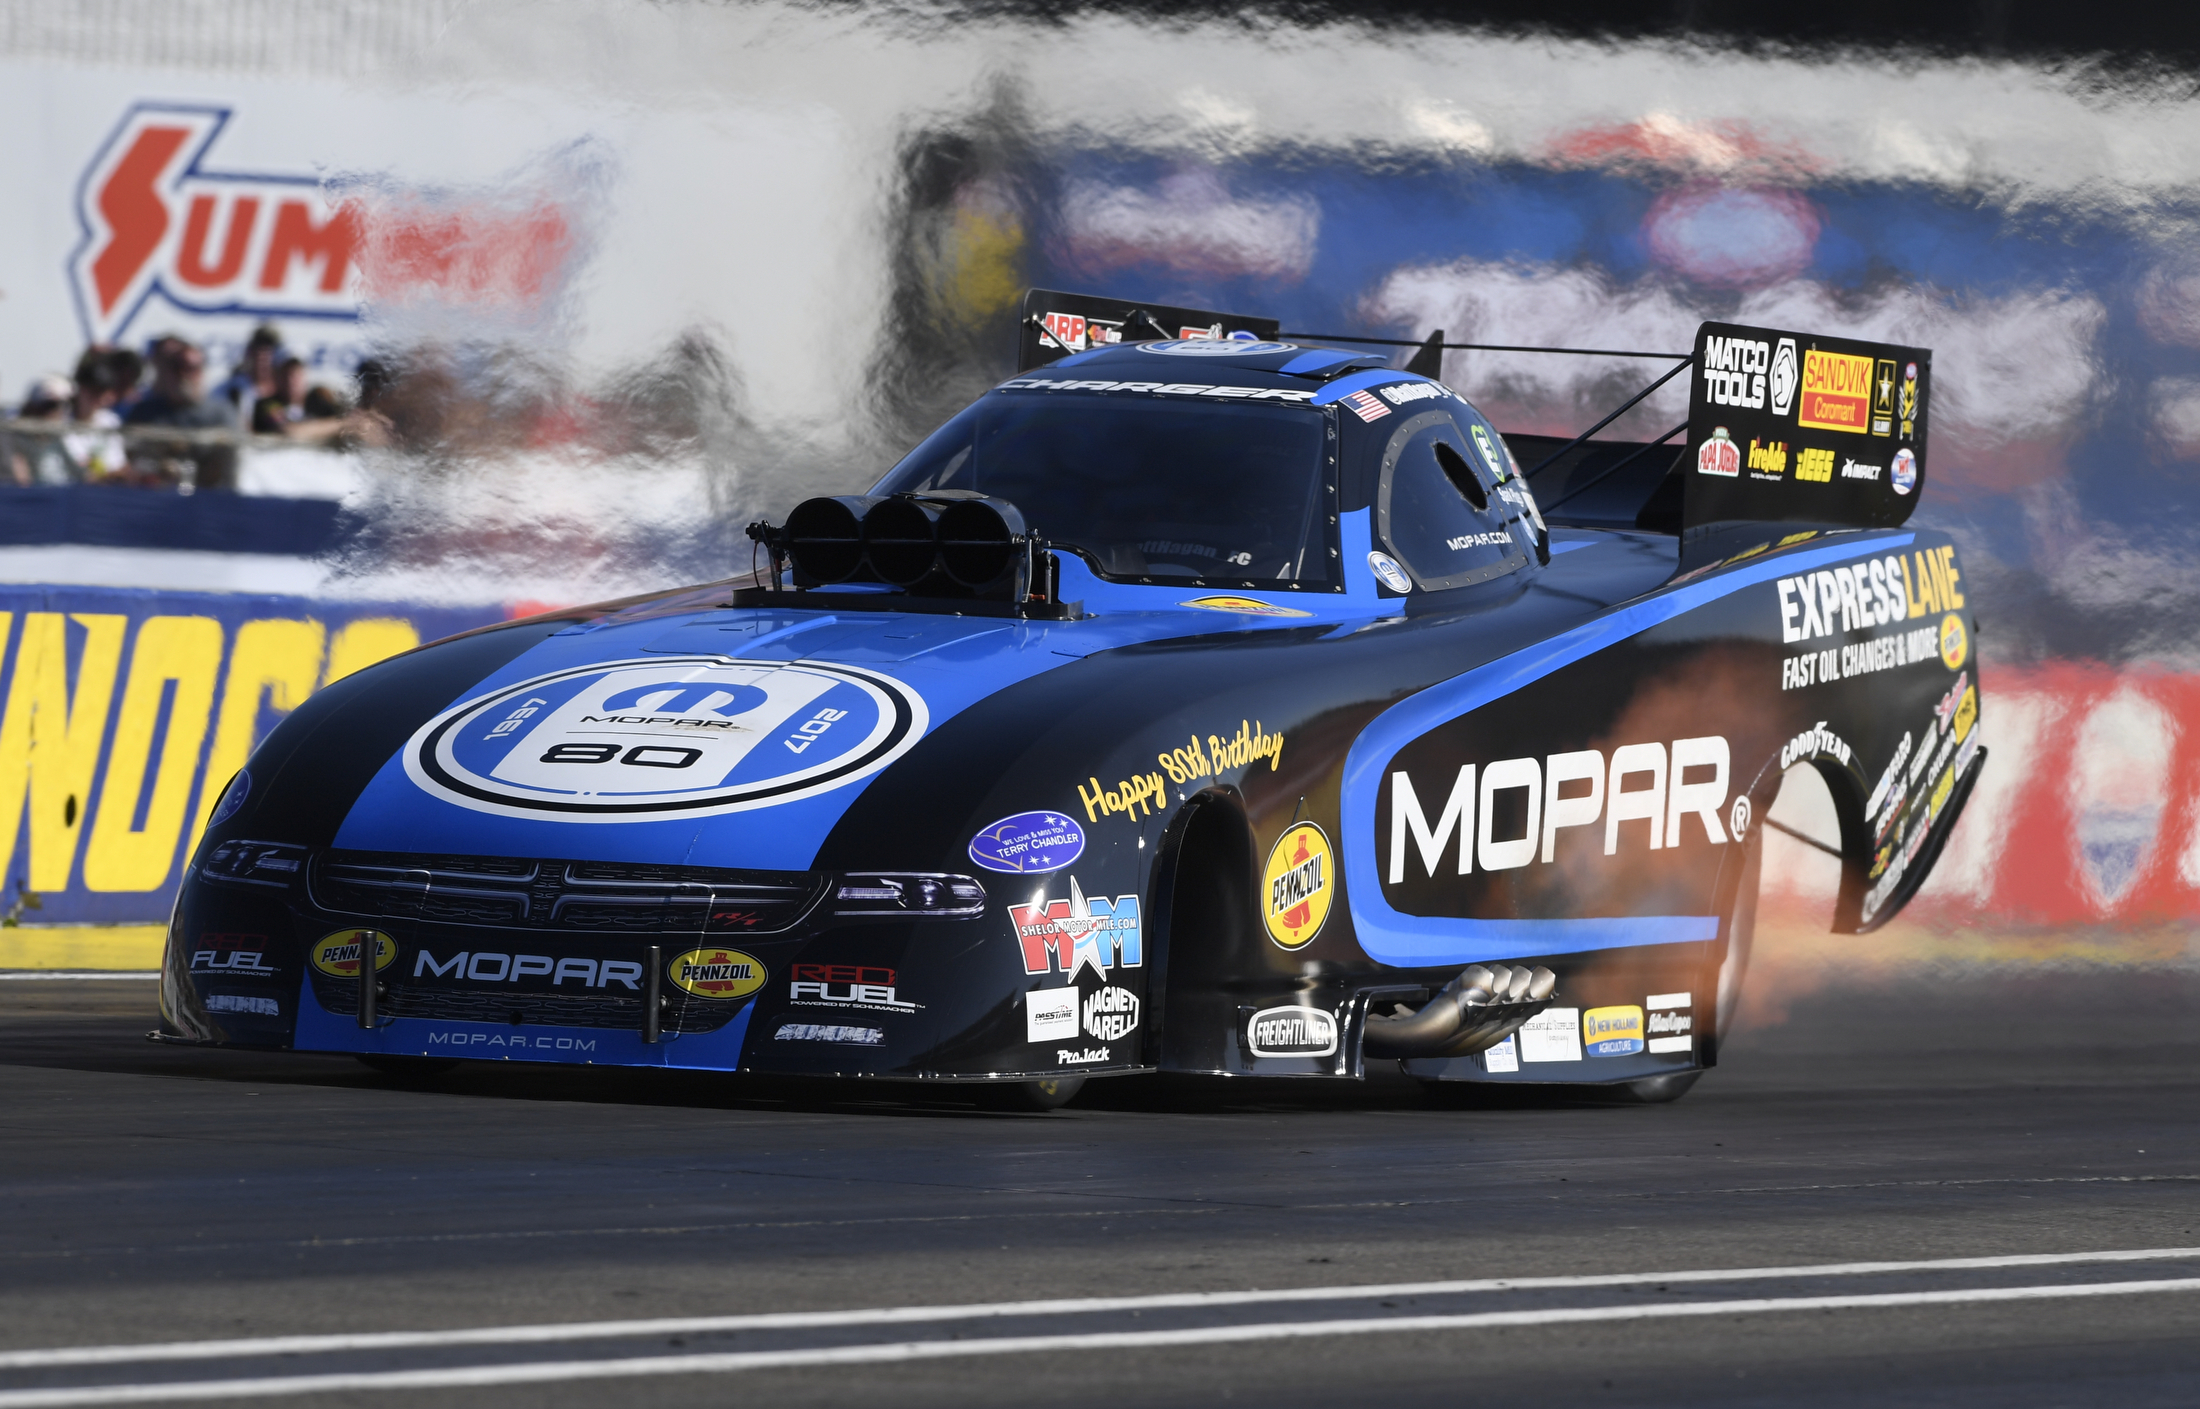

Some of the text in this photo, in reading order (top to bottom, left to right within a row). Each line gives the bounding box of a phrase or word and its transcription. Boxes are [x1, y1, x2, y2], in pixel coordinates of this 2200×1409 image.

[1705, 335, 1769, 374] MATCO
[1805, 354, 1871, 395] SANDVIK
[1000, 378, 1319, 402] CHARGER
[1704, 369, 1766, 409] TOOLS
[1814, 396, 1856, 422] Coromant
[1748, 439, 1786, 473] FireAde
[1795, 448, 1835, 483] JEGS
[1446, 532, 1513, 551] MOPAR.COM
[1782, 653, 1818, 690] FAST
[1819, 648, 1841, 684] OIL
[1841, 634, 1897, 678] CHANGES
[1897, 633, 1906, 666] &
[1907, 626, 1939, 664] MORE
[483, 697, 548, 741] 1937
[580, 716, 734, 729] MOPAR
[784, 707, 849, 754] 2017
[538, 743, 703, 769] 80
[1780, 721, 1851, 770] GOODYEAR
[1077, 719, 1284, 823] Happy 80th Birthday
[996, 833, 1079, 859] TERRY CHANDLER
[1015, 833, 1031, 844] LOVE
[1037, 829, 1052, 837] MISS
[1051, 826, 1064, 834] YOU
[1271, 852, 1325, 919] PENNZOIL
[1021, 917, 1137, 937] SHELOR MOTOR MILE.COM
[190, 950, 274, 972] FUEL
[413, 949, 643, 991] MOPAR
[680, 963, 757, 982] PENNZOIL
[791, 963, 897, 986] RED
[790, 981, 916, 1008] FUEL
[852, 1003, 916, 1014] SCHUMACHER
[1255, 1018, 1331, 1046] FREIGHTLINER
[1597, 1017, 1638, 1033] NEW HOLLAND
[428, 1032, 596, 1051] MOPAR.COM
[1598, 1039, 1632, 1054] AGRICULTURE
